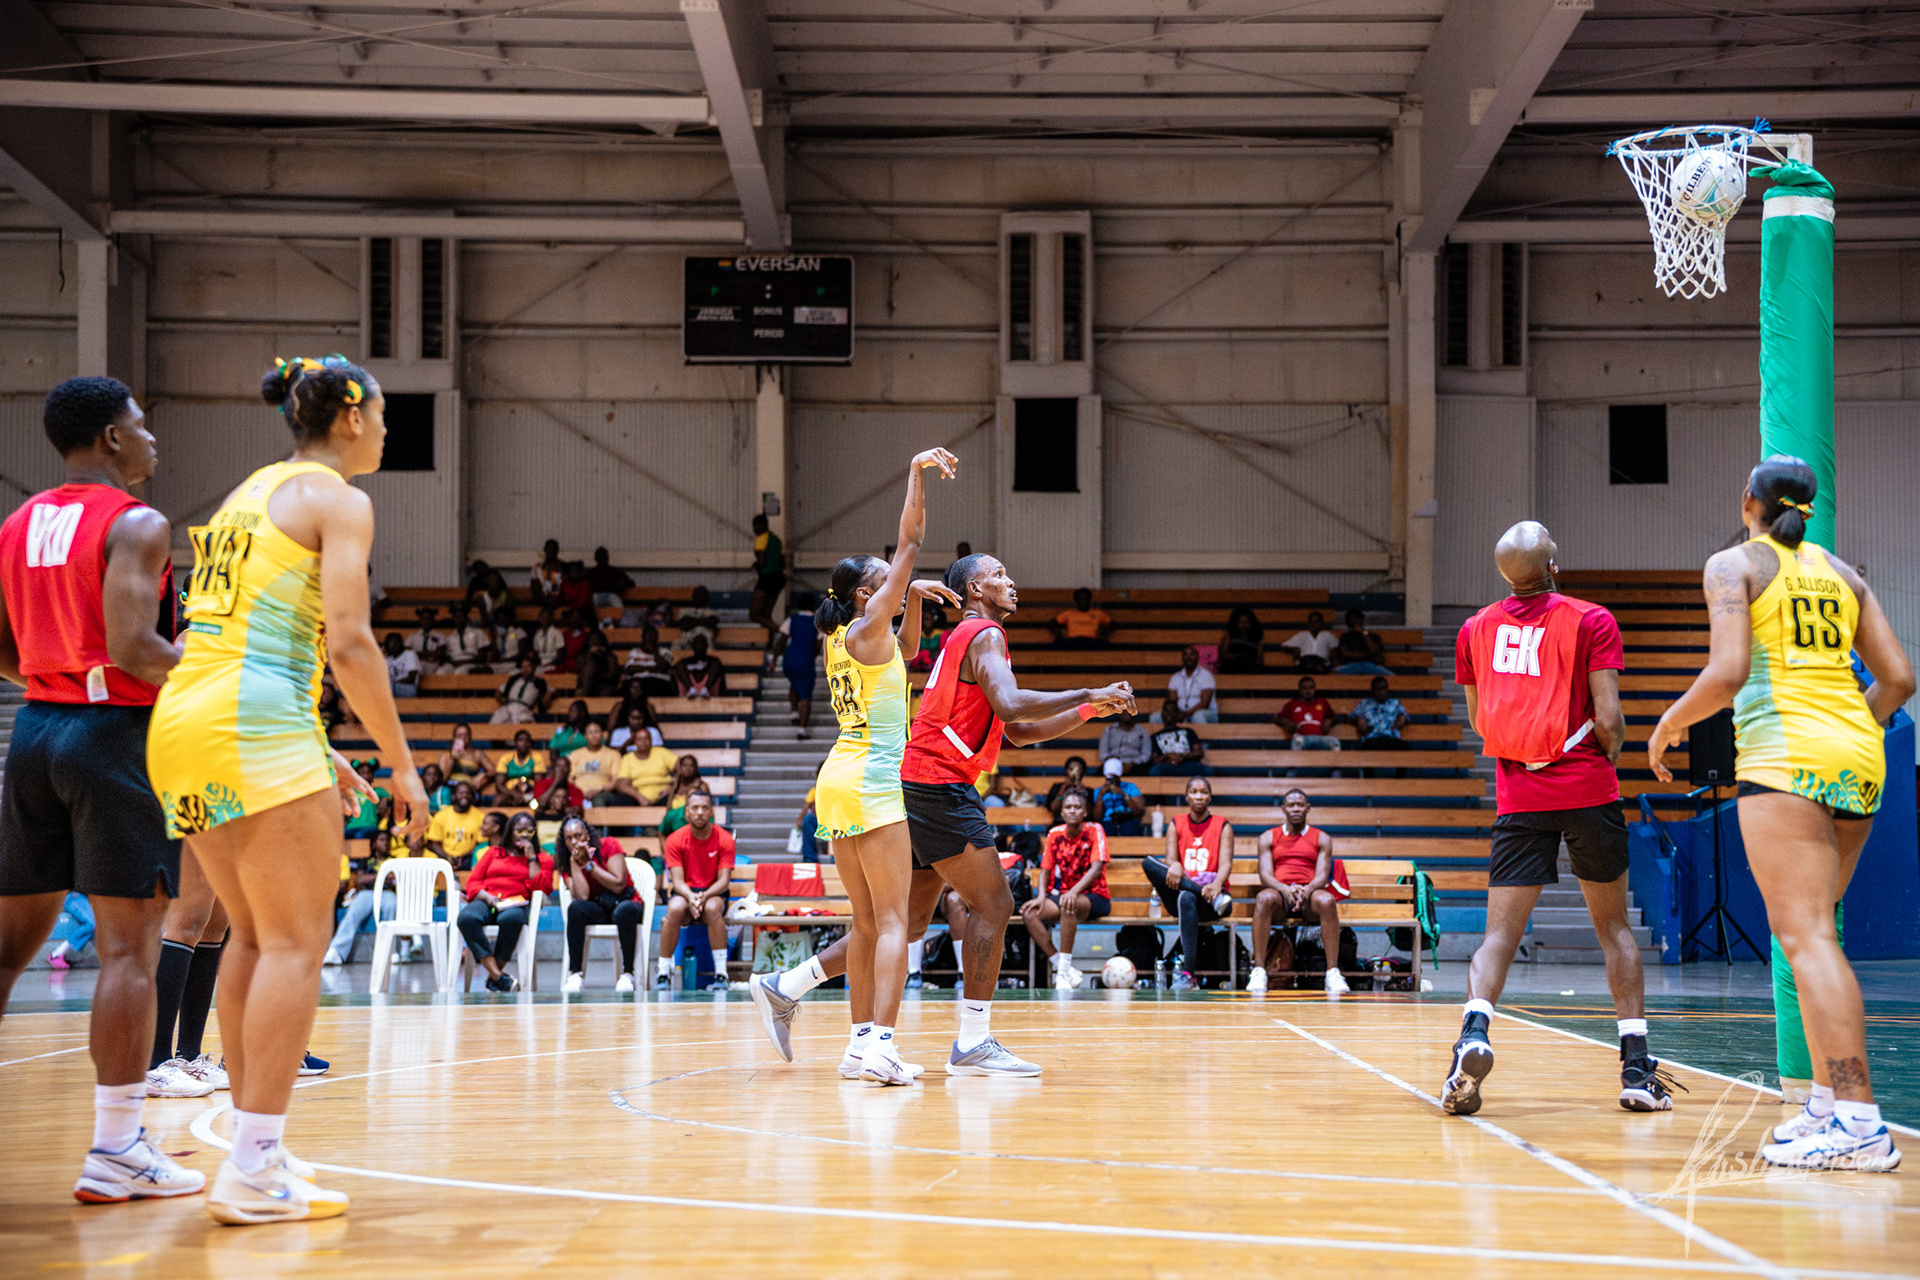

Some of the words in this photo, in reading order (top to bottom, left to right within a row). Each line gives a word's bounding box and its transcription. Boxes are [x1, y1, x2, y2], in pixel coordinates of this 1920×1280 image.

[1683, 156, 1713, 201] GILBERT
[735, 258, 820, 271] EVERSAN
[753, 306, 783, 316] BONUS
[753, 329, 785, 339] PERIOD
[1797, 577, 1841, 595] ALLISON
[1790, 595, 1842, 650] GS
[1492, 624, 1545, 677] GK
[831, 675, 862, 717] GA
[1184, 848, 1209, 871] GS
